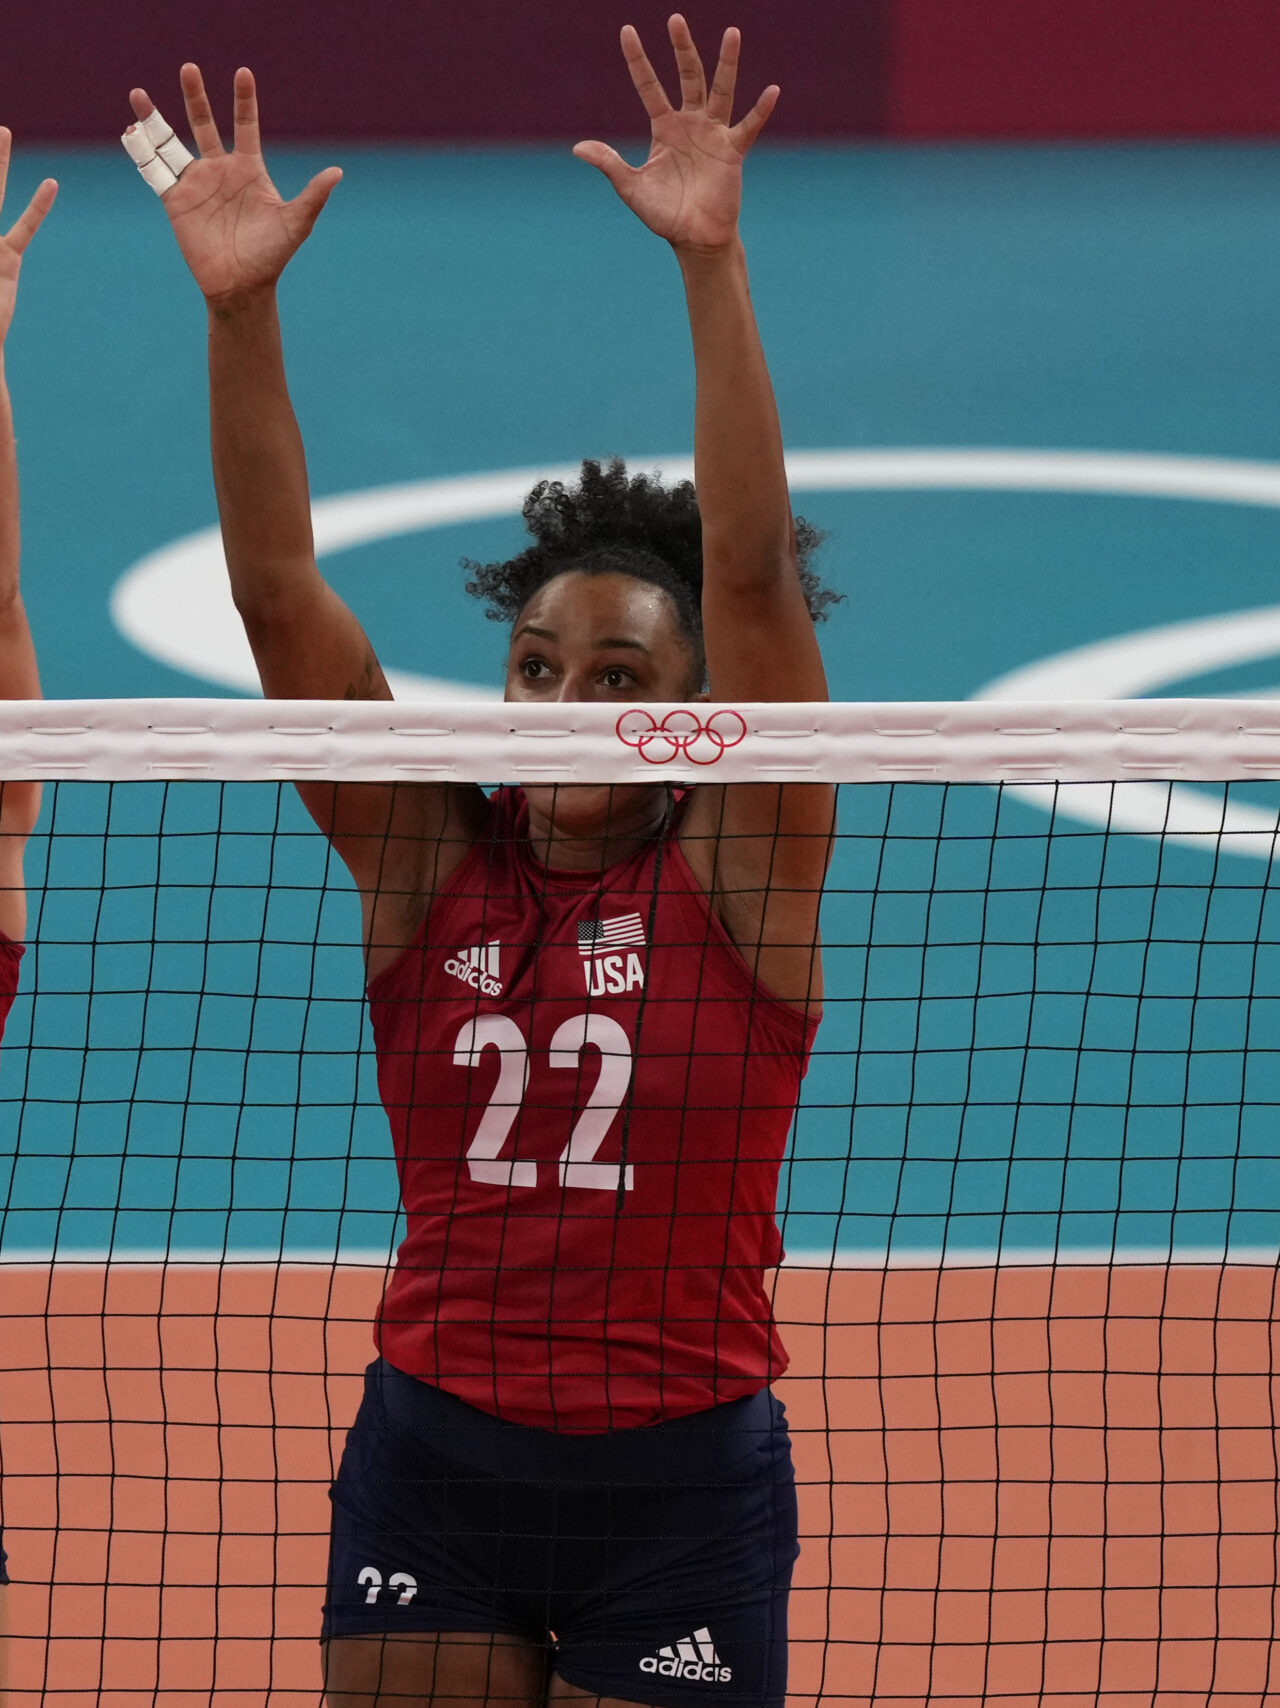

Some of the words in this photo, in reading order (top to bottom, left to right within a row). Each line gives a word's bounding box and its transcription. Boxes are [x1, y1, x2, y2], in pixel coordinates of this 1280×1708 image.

[443, 957, 504, 997] adidas
[582, 952, 646, 997] USA
[452, 1013, 635, 1191] 22
[638, 1656, 733, 1682] adidas
